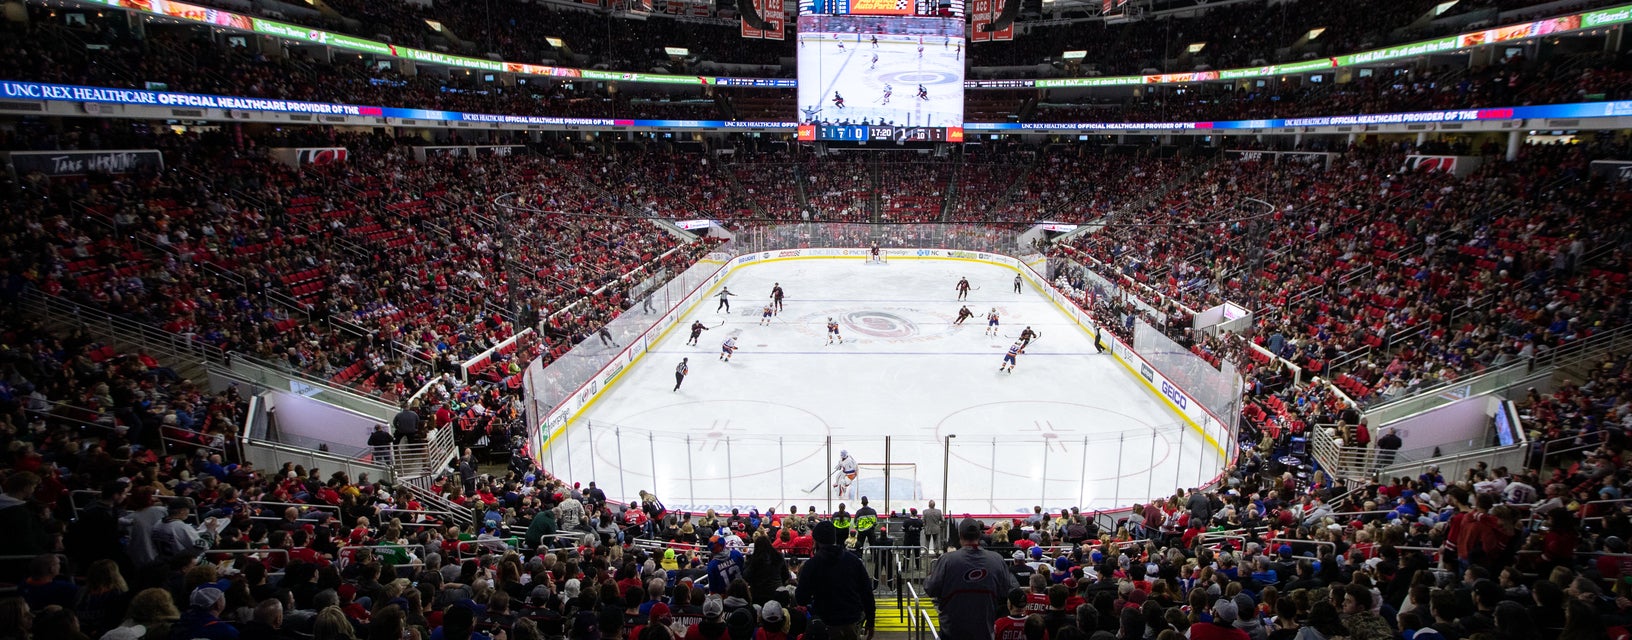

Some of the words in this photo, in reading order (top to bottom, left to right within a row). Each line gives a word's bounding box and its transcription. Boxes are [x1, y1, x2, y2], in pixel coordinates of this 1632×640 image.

[976, 0, 988, 11] ACC
[4, 83, 41, 97] UNC
[42, 86, 72, 99] REX
[73, 87, 157, 104] HEALTHCARE
[158, 94, 218, 107] OFFICIAL
[218, 98, 286, 111] HEALTHCARE
[288, 102, 331, 114] PROVIDER
[332, 104, 344, 114] OF
[344, 105, 360, 115] THE
[1330, 116, 1357, 124] OFFICIAL
[1358, 114, 1403, 124] HEALTHCARE
[1403, 112, 1444, 122] PROVIDER
[1445, 112, 1458, 120] OF
[1458, 110, 1478, 120] THE
[856, 128, 862, 138] 0
[872, 128, 892, 136] 17:20
[901, 129, 906, 138] 1
[1162, 380, 1187, 410] GEICO
